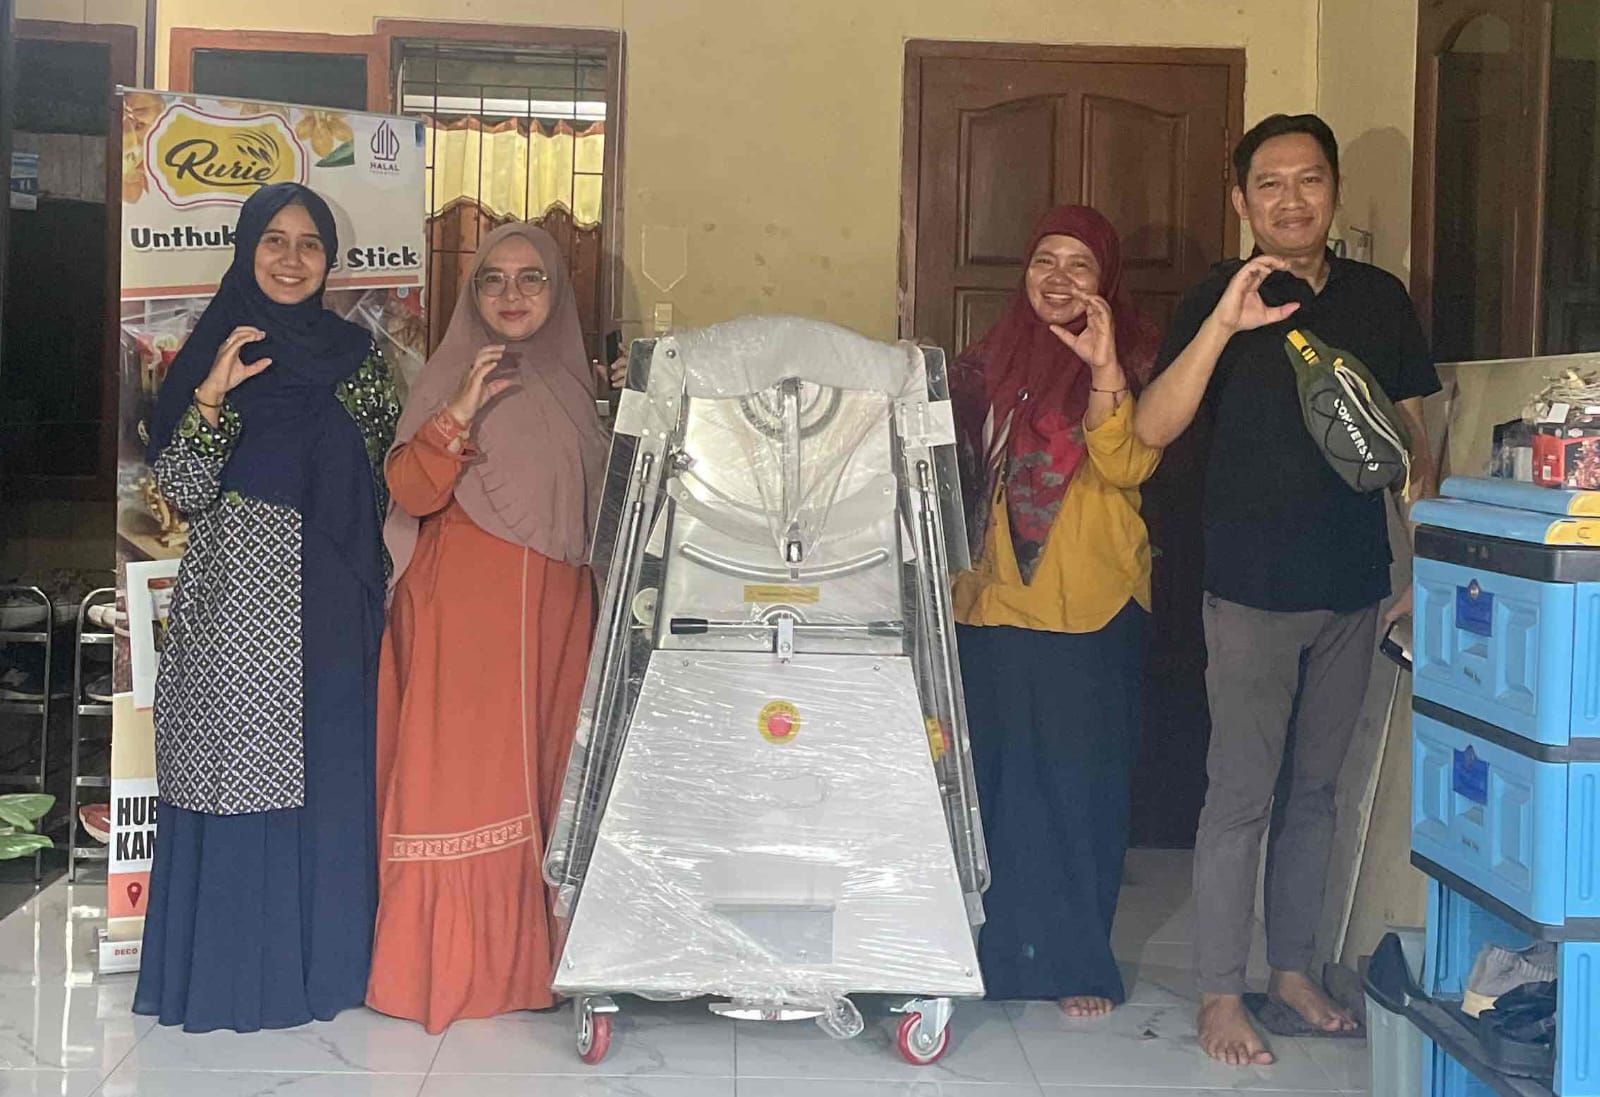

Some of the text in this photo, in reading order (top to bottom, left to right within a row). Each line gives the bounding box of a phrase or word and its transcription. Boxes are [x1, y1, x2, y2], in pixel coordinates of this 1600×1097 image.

[165, 138, 274, 187] Rurie
[370, 162, 400, 171] HALAL
[131, 225, 236, 248] Unthuk
[347, 246, 417, 268] Stick
[1333, 398, 1375, 463] CONVERSE
[114, 948, 138, 956] DECO
